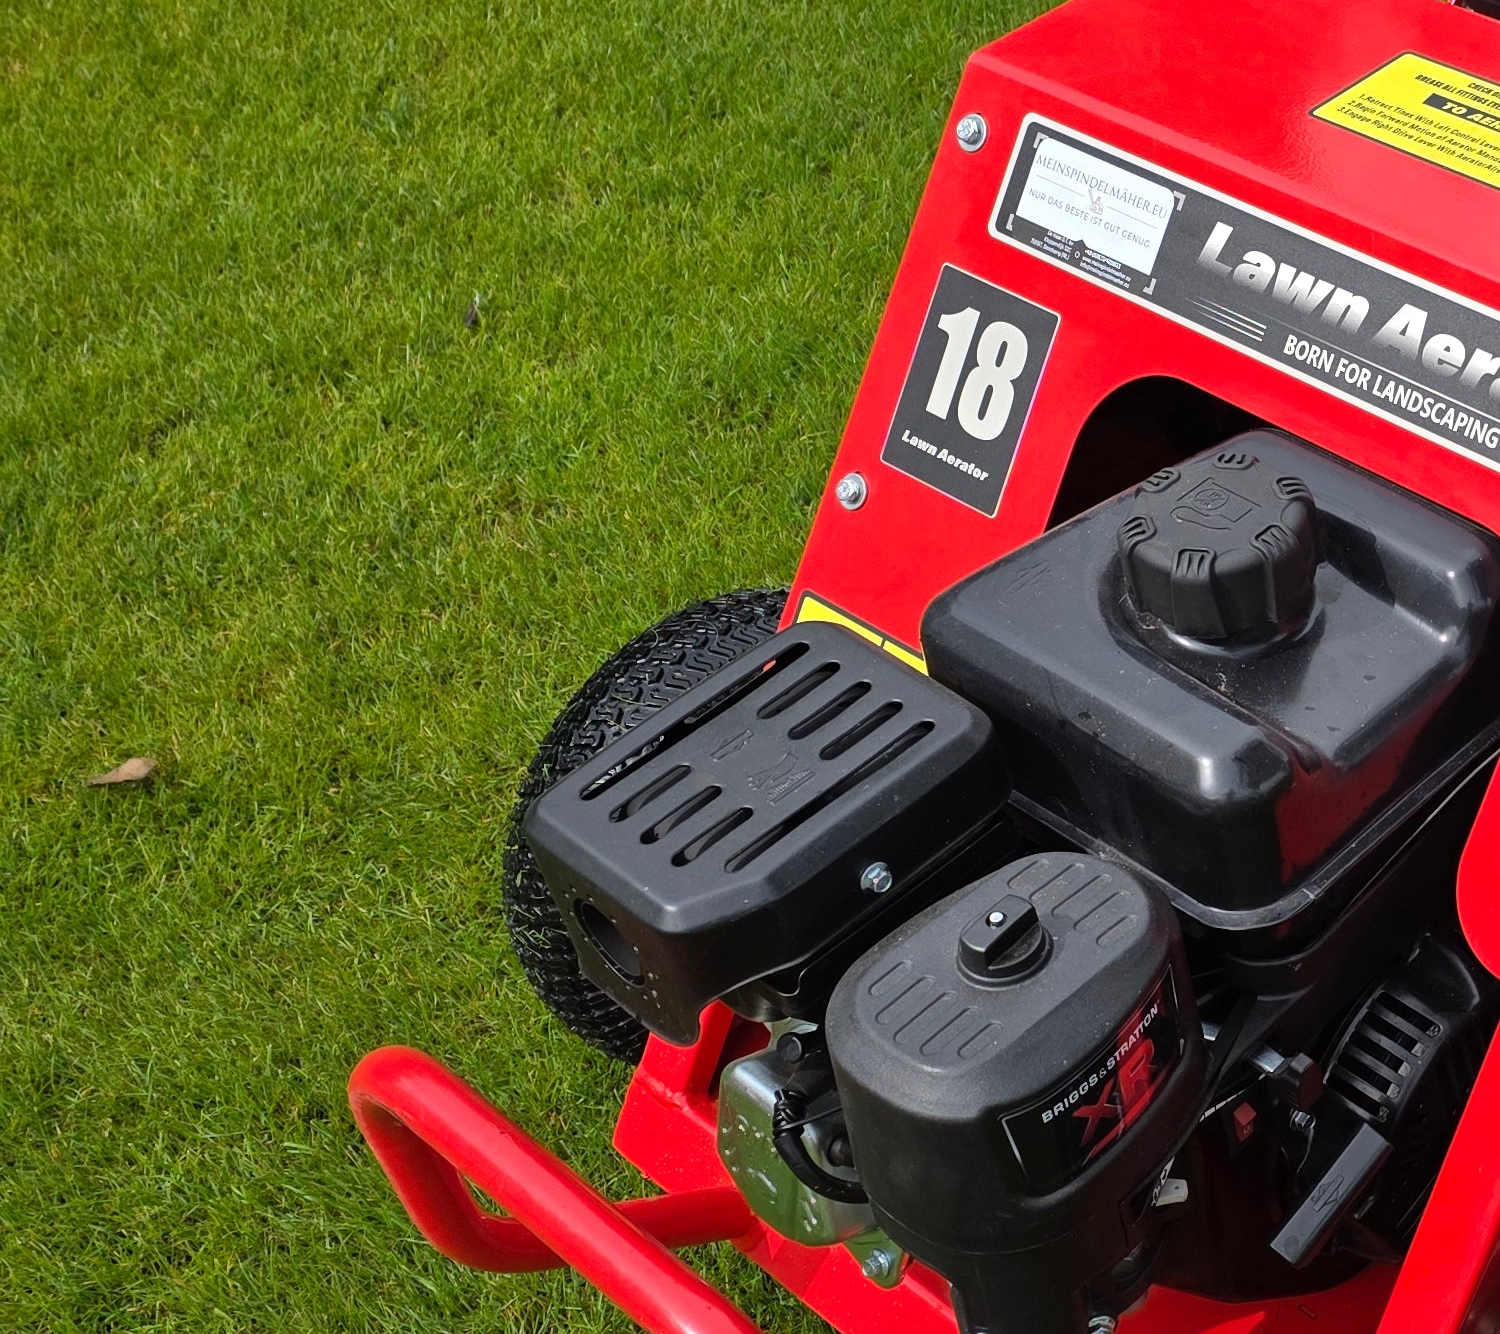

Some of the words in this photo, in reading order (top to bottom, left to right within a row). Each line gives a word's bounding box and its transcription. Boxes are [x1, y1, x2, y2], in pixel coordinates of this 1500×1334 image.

[1441, 84, 1458, 93] ALL
[1441, 101, 1468, 115] TO
[1371, 119, 1394, 132] Right
[1392, 128, 1415, 140] Drive
[1413, 136, 1438, 148] Lever
[1436, 144, 1456, 156] With
[1375, 110, 1409, 127] Forward
[1408, 123, 1438, 137] Motion
[1445, 138, 1477, 153] Aerator
[1392, 106, 1415, 118] Tines
[1414, 114, 1434, 126] With
[1433, 122, 1451, 133] Left
[1450, 129, 1480, 143] Control
[1035, 154, 1168, 219] MEINSPINDELMÄHER.EU
[1028, 187, 1047, 201] NUR
[1047, 196, 1063, 209] DAS
[1064, 203, 1089, 221] BESTE
[1090, 215, 1104, 226] IST
[1103, 221, 1121, 235] GUT
[1121, 229, 1151, 249] GENUG.
[1198, 221, 1371, 335] Lawn
[926, 306, 1029, 441] 18
[1283, 334, 1335, 373] BORN
[1334, 357, 1371, 391] FOR
[901, 429, 938, 457] Lawn
[936, 448, 990, 481] Aerator
